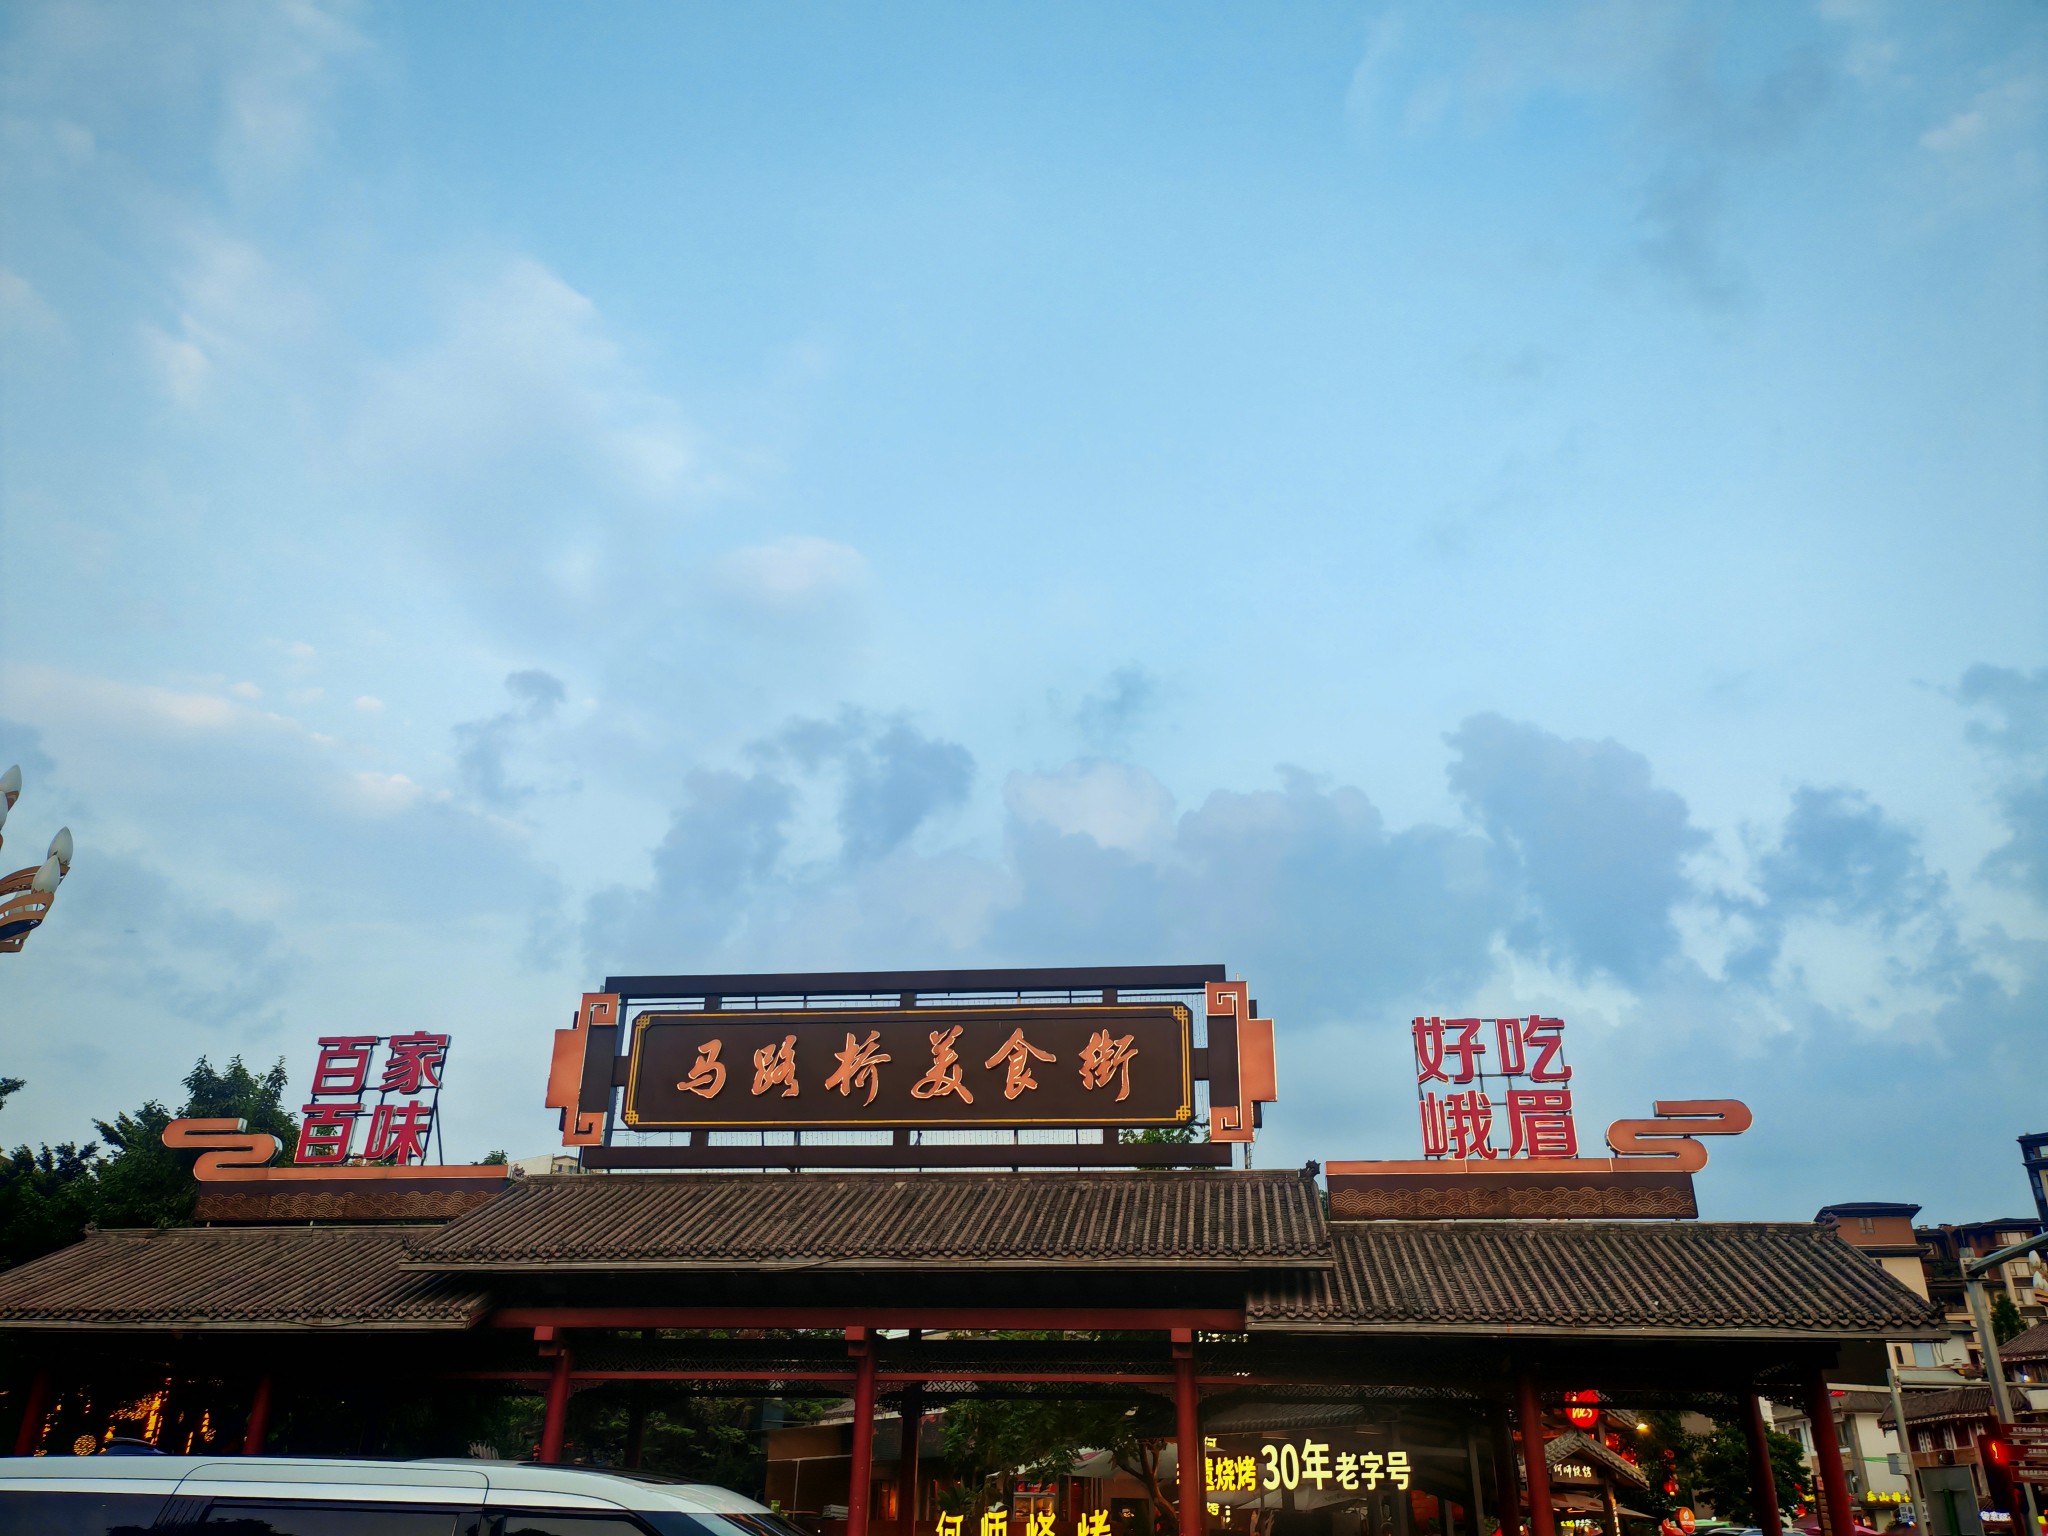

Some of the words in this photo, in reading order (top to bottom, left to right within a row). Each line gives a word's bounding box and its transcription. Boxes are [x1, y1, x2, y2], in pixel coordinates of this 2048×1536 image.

[311, 1031, 452, 1095] 百家
[1412, 1015, 1574, 1084] 好吃
[294, 1100, 433, 1166] 百味
[1419, 1089, 1579, 1160] 峨眉
